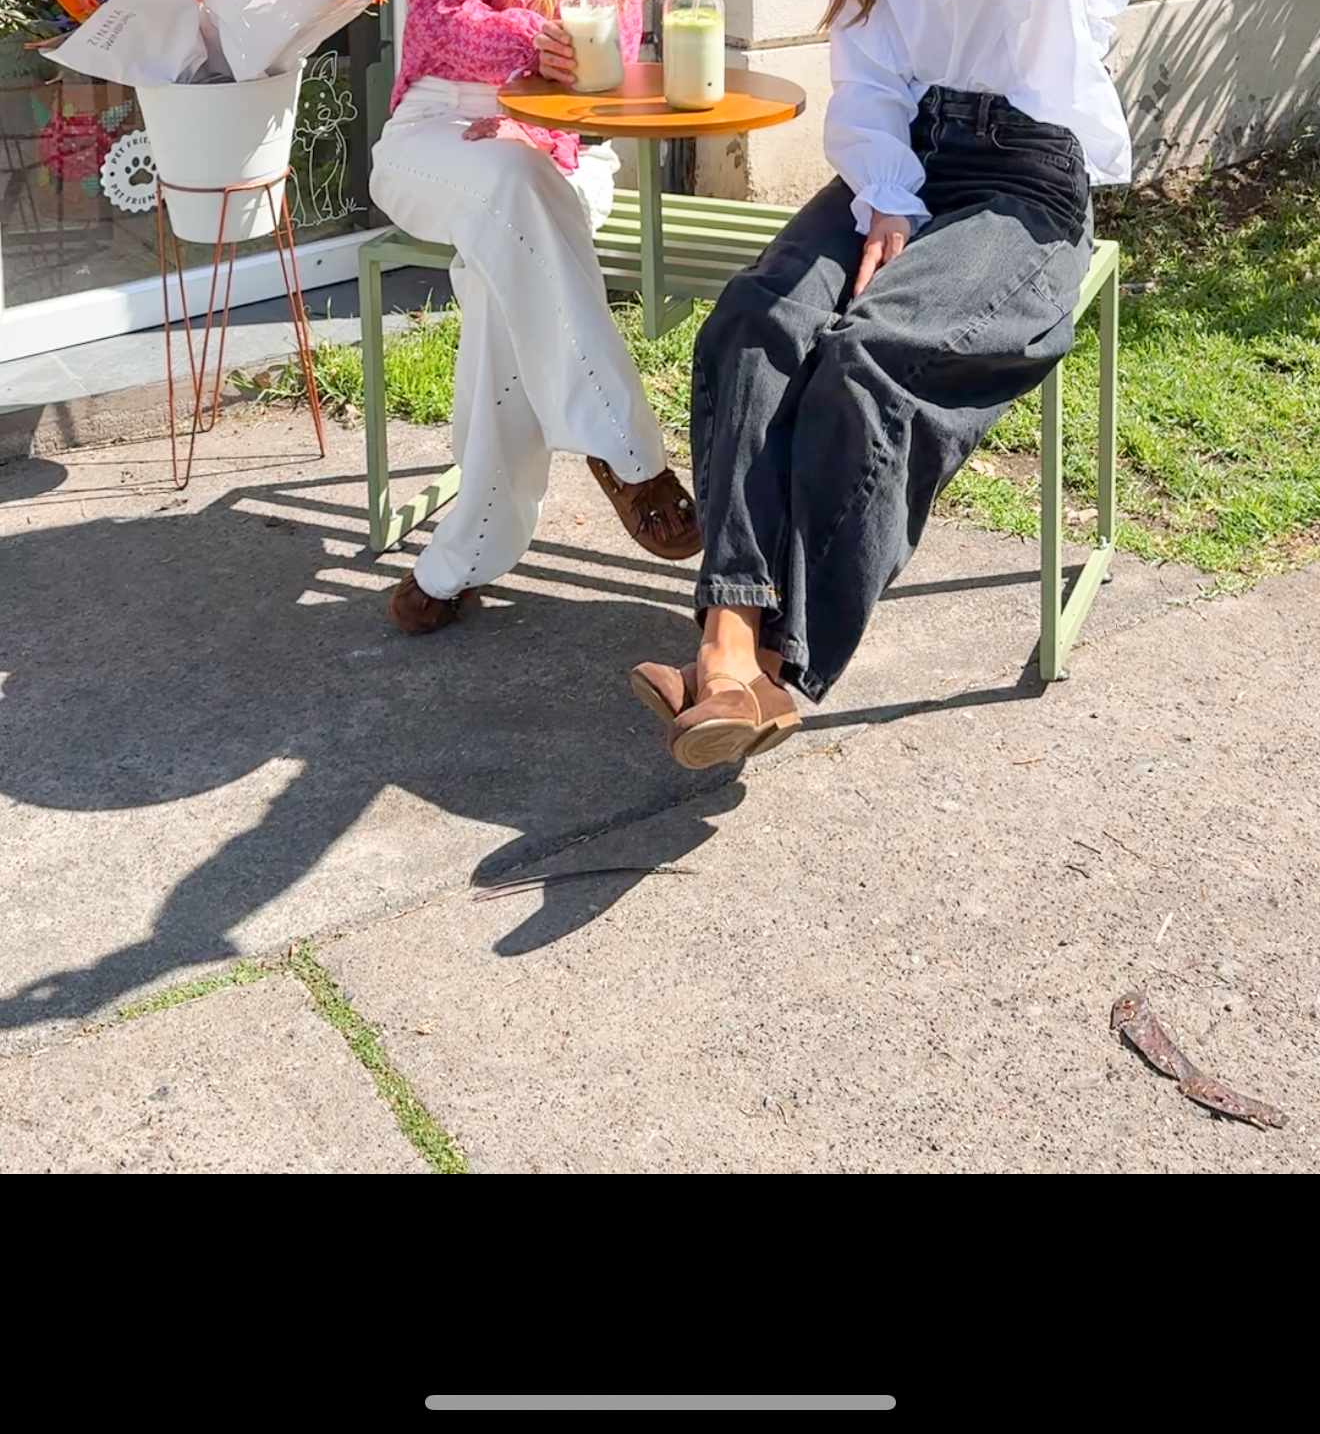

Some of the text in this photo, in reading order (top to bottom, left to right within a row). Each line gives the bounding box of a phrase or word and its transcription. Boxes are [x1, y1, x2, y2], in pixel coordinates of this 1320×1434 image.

[86, 9, 124, 46] ZINNIA
[111, 136, 151, 164] PET FRIE
[111, 183, 158, 205] PET FRIEN
